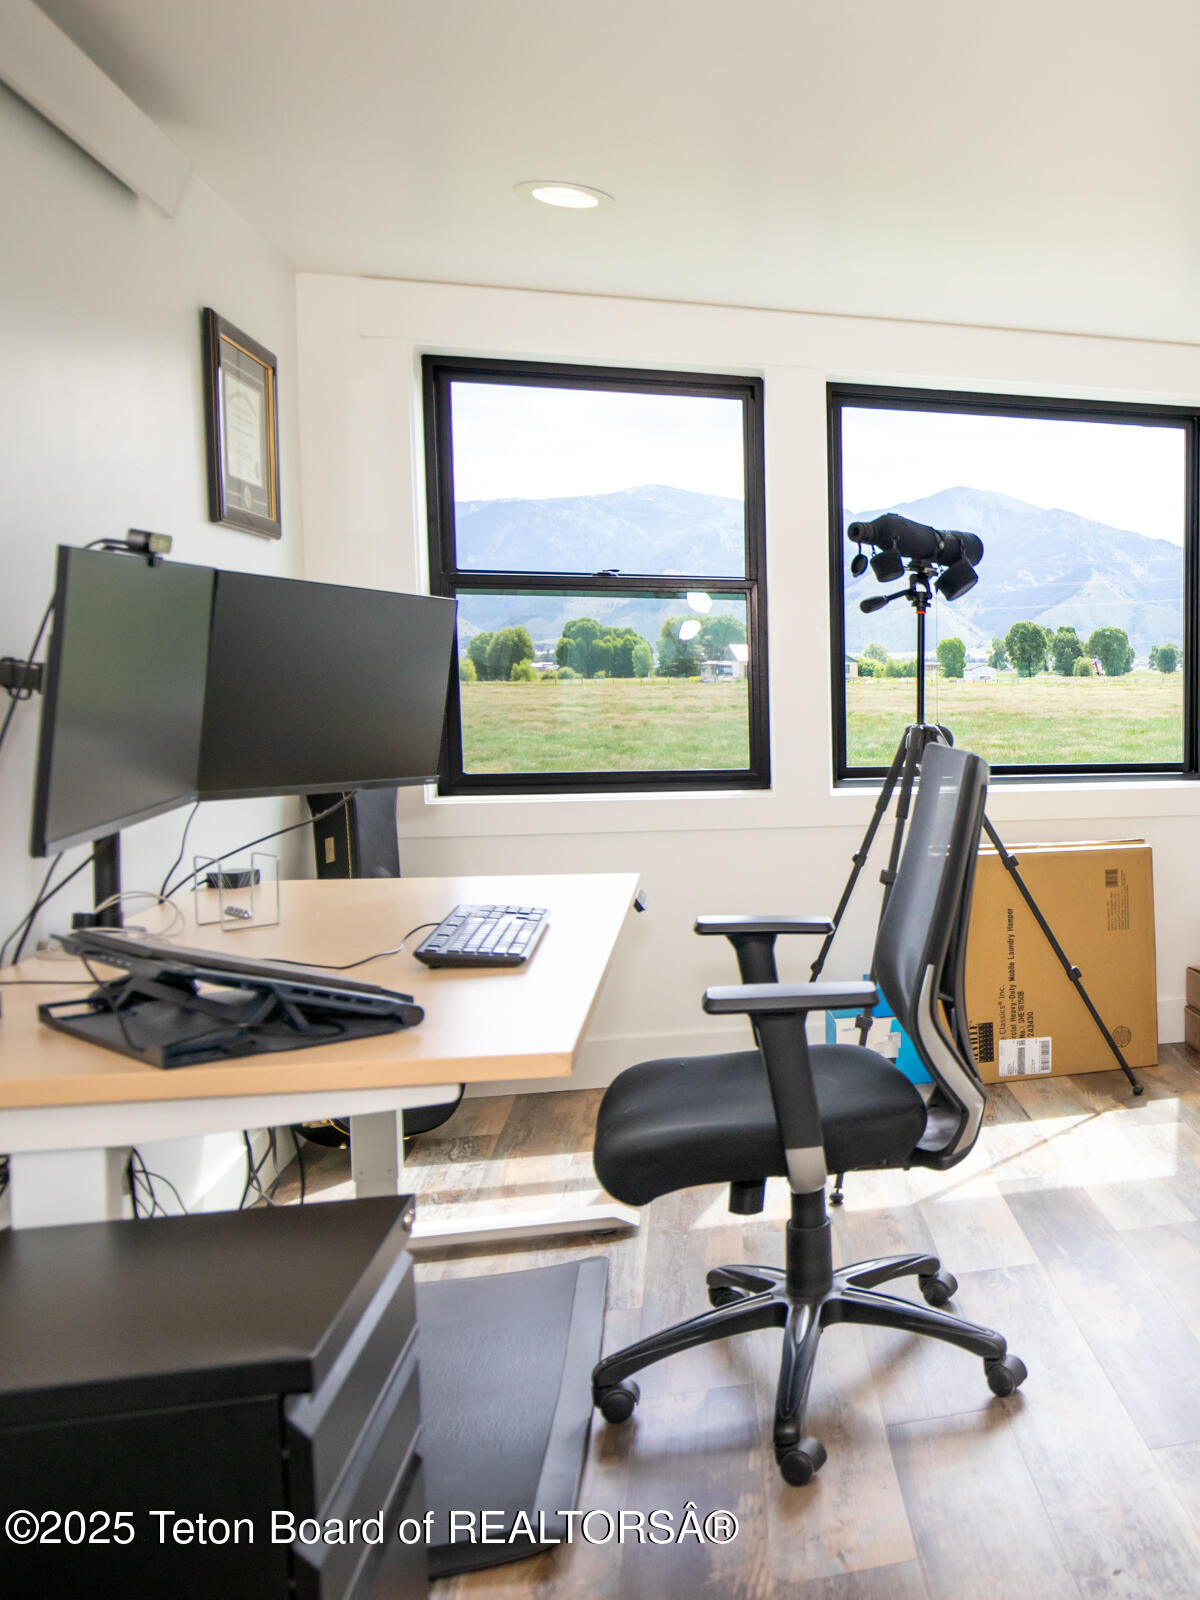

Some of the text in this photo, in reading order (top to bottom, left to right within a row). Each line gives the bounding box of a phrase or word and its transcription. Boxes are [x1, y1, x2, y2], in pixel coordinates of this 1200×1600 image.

[1006, 908, 1014, 932] Hamper
[1007, 934, 1015, 960] Laundry
[1009, 984, 1017, 1022] Heavy-Duty
